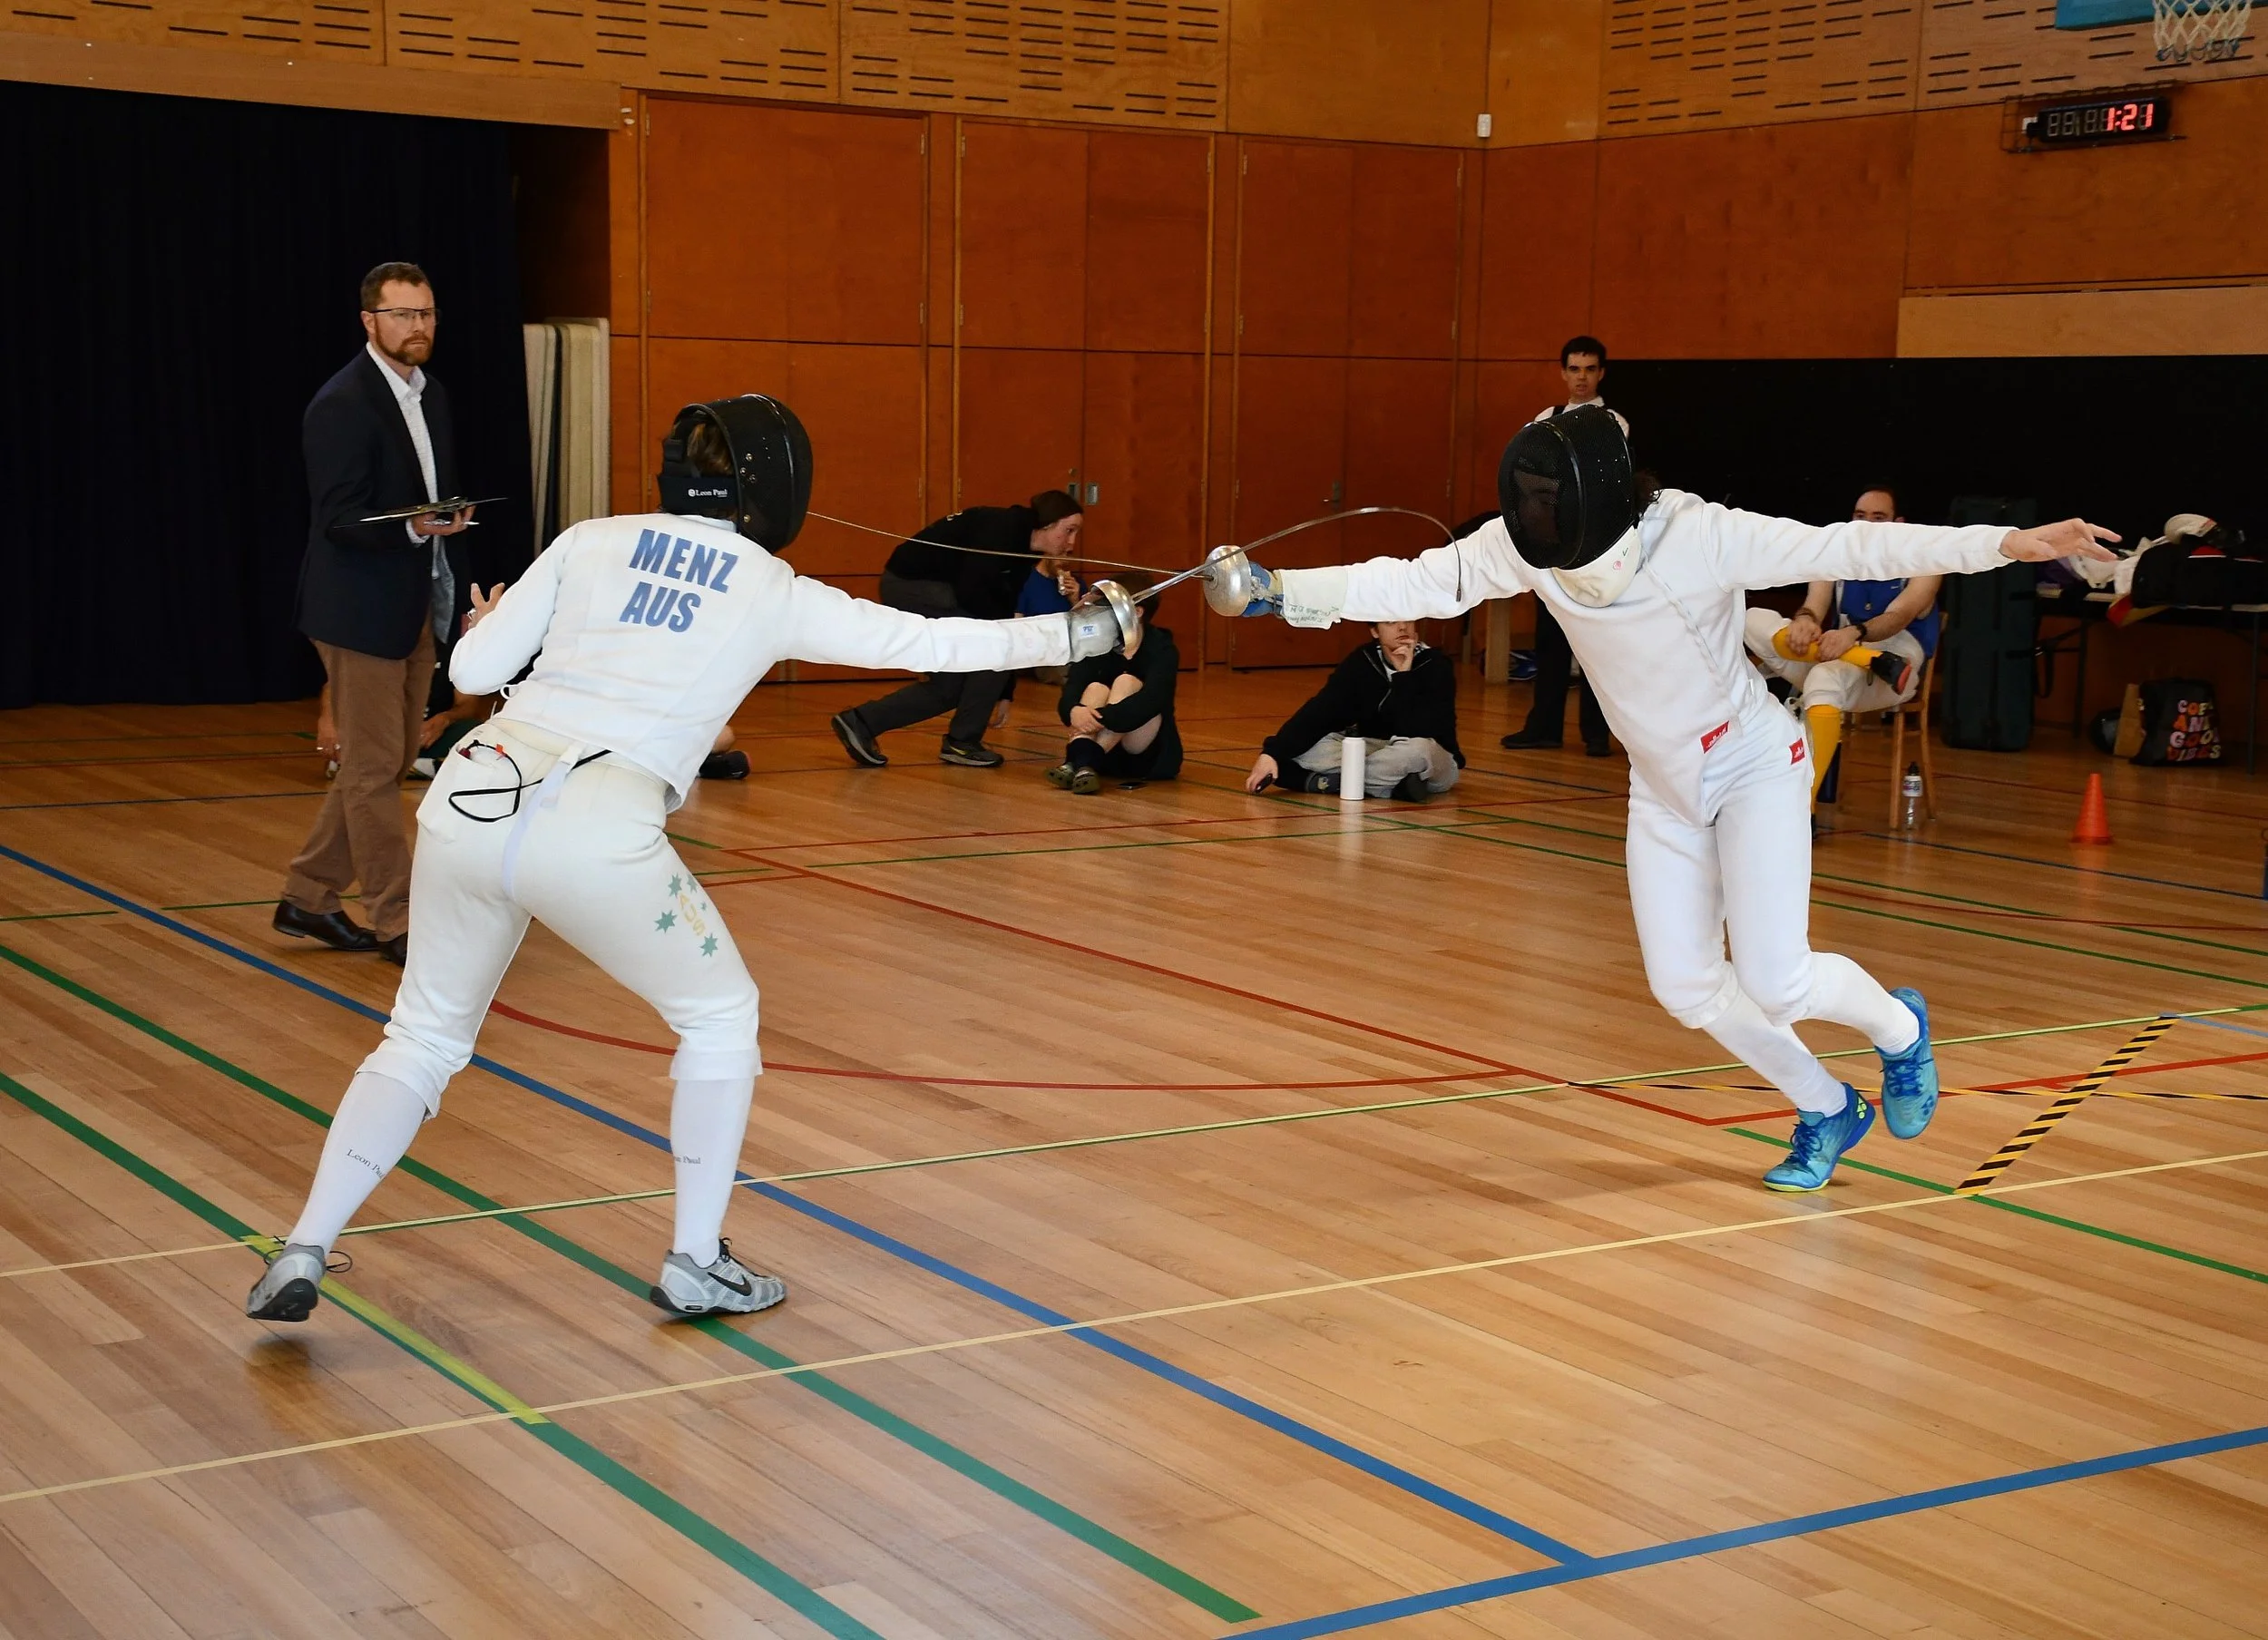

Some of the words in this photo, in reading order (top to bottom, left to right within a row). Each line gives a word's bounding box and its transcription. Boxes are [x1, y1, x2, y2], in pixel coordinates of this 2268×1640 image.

[2107, 103, 2154, 132] 1:21
[629, 528, 739, 594] MENZ
[619, 581, 702, 633] AUS
[679, 893, 706, 936] AUS
[347, 1148, 371, 1167] Leon
